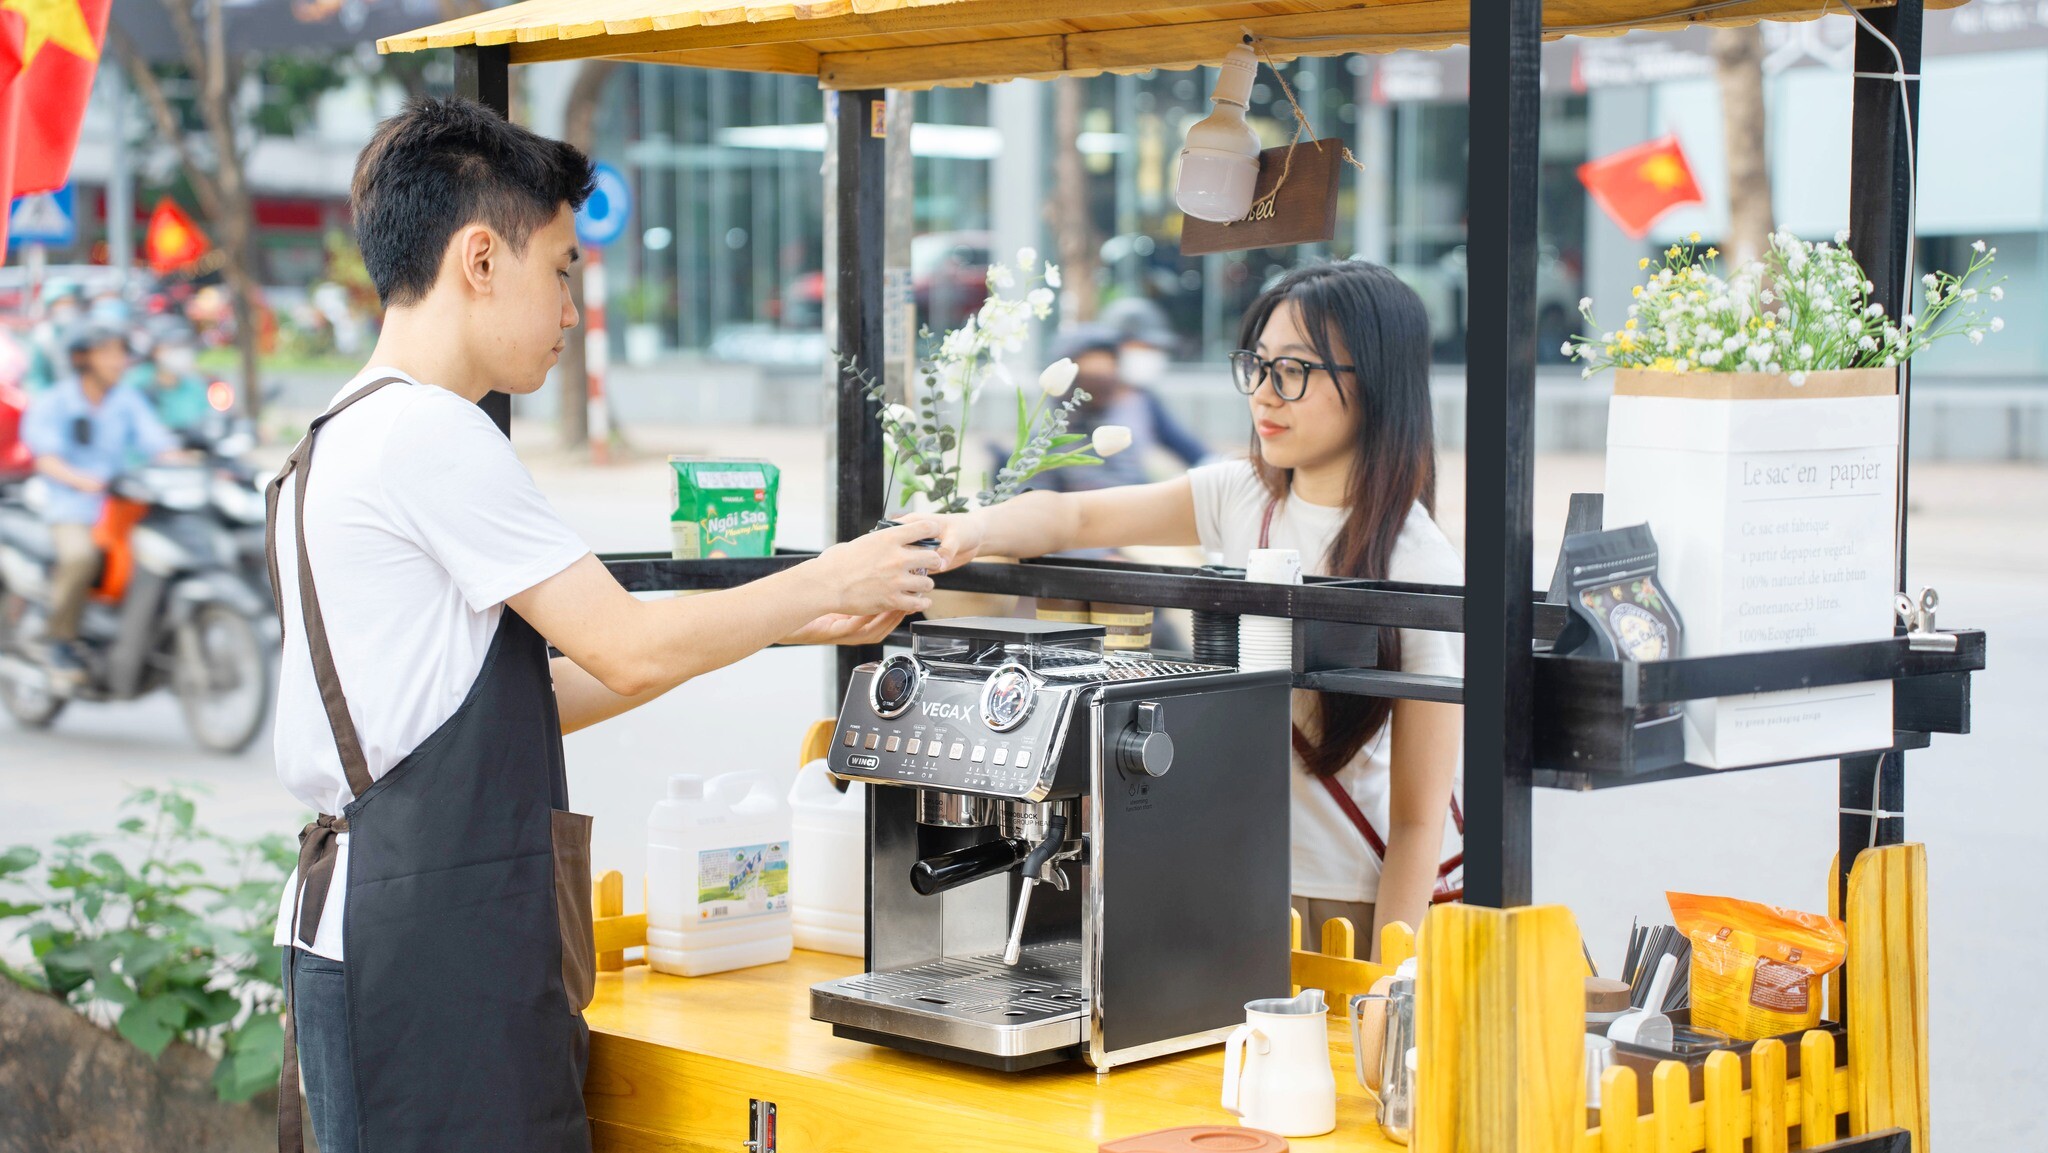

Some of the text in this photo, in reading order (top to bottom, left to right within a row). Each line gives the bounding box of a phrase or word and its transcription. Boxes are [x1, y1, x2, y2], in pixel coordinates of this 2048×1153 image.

[1743, 462, 1762, 485] Le
[1797, 465, 1817, 483] en
[1829, 456, 1881, 489] papier
[708, 510, 767, 534] Ngôi Sao
[1741, 522, 1755, 536] Ce
[1758, 523, 1773, 535] sac
[1775, 520, 1789, 534] est
[1749, 548, 1778, 567] partir
[1741, 574, 1769, 591] 100%
[1822, 567, 1844, 584] kraft
